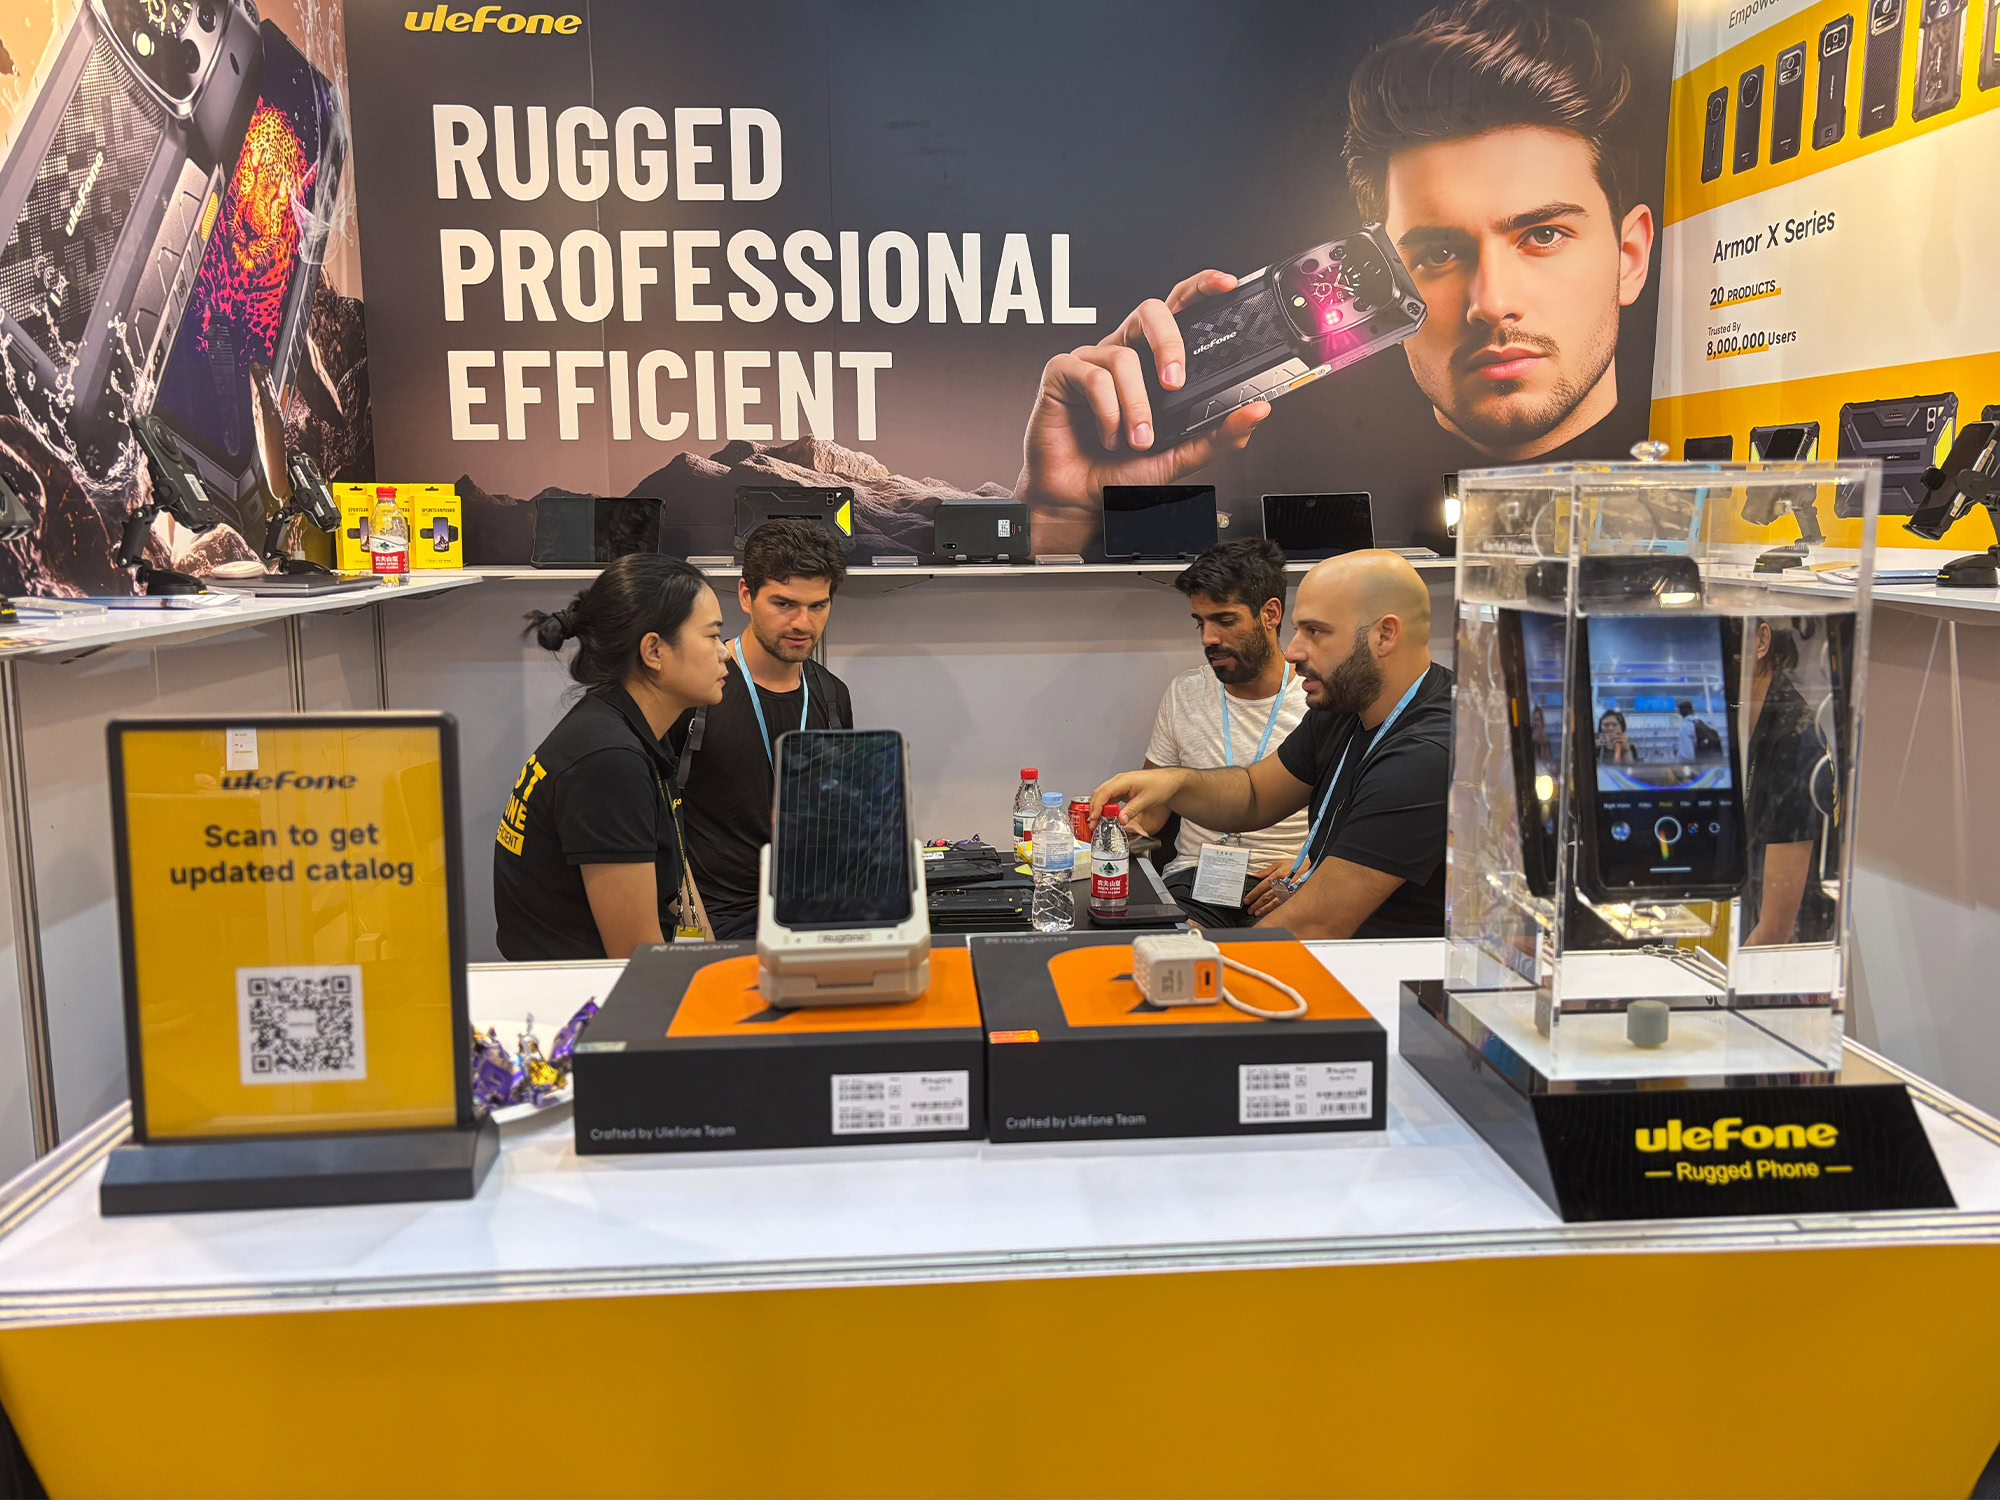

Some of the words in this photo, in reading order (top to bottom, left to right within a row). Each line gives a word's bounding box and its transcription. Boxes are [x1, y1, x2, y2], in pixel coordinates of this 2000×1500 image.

[433, 105, 782, 201] RUGGED
[1713, 238, 1762, 263] Armor
[1766, 222, 1780, 248] X
[1784, 210, 1835, 244] Series
[440, 229, 1096, 323] PROFESSIONAL
[1710, 286, 1724, 306] 20
[1727, 279, 1776, 302] PRODUCTS
[1708, 323, 1731, 336] Trusted
[1732, 321, 1741, 332] By
[1706, 331, 1765, 359] 8,000,000
[1768, 330, 1797, 345] Users
[448, 350, 892, 441] EFFICIENT
[204, 825, 277, 847] Scan
[289, 825, 318, 846] to
[330, 823, 379, 851] get
[170, 859, 295, 890] updated
[306, 857, 414, 885] catalog
[590, 1128, 636, 1141] Crafted
[638, 1127, 653, 1140] by
[704, 1125, 736, 1137] Team
[1006, 1115, 1050, 1129] Crafted
[1052, 1115, 1066, 1129] by
[1115, 1113, 1146, 1126] Team
[1676, 1161, 1752, 1184] Rugged
[1756, 1159, 1819, 1179] Phone
